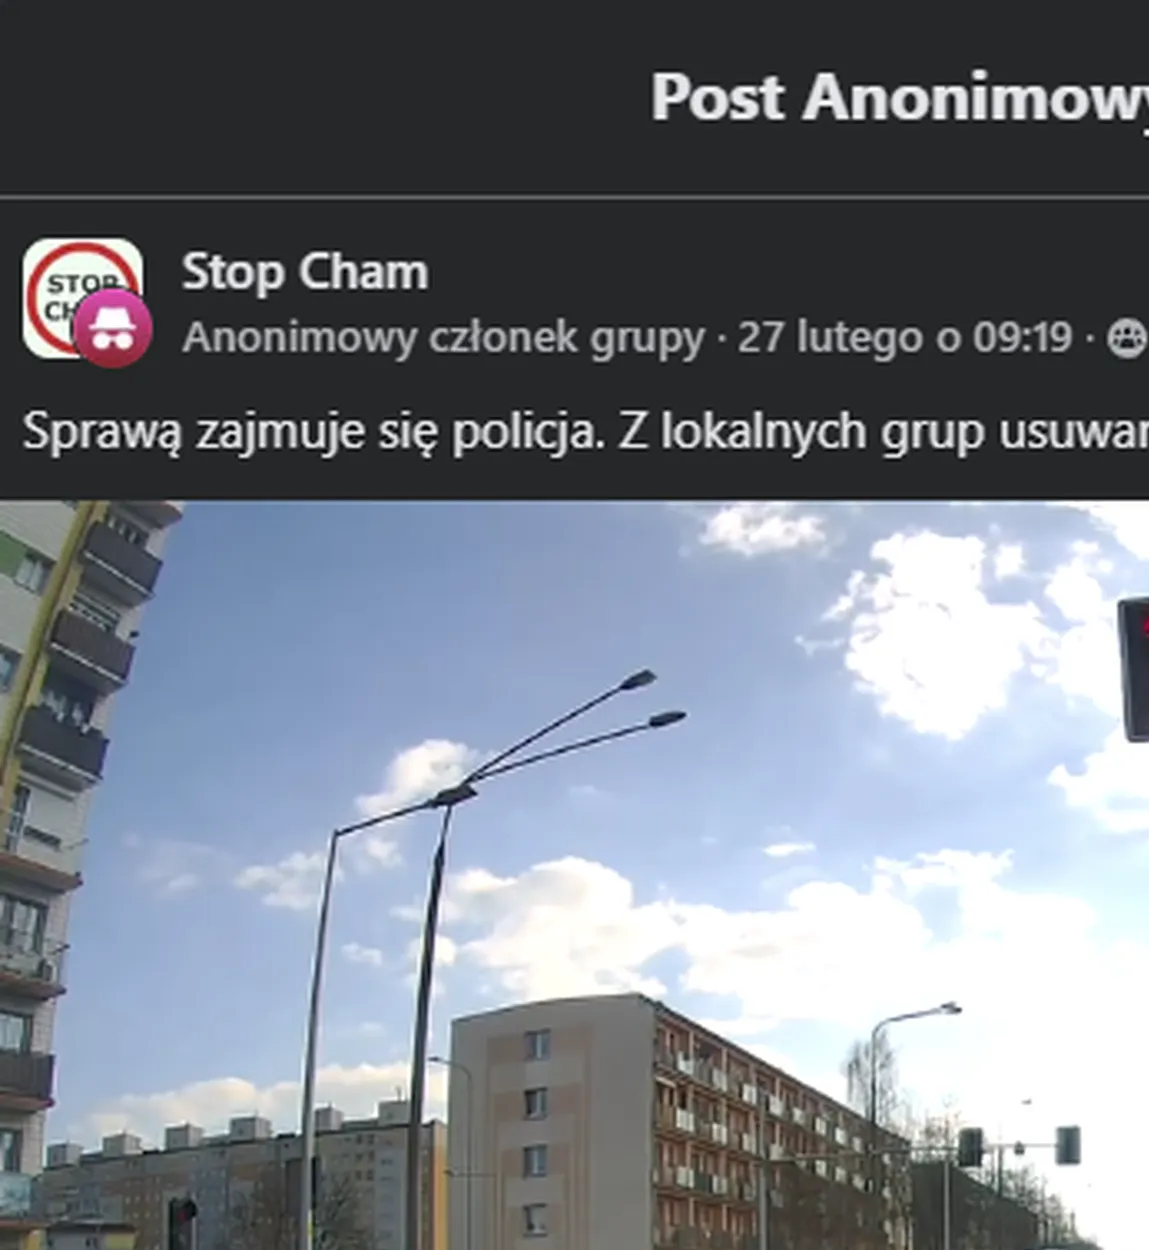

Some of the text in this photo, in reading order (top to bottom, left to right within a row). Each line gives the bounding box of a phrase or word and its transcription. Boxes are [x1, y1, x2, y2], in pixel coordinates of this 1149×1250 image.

[653, 72, 786, 120] Post
[182, 251, 428, 299] Stop Cham
[182, 318, 1072, 362] Anonimowy członek grupy 27 lutego o 09:19
[23, 410, 182, 458] Sprawą
[196, 410, 365, 458] zajmuje
[379, 410, 438, 458] się
[454, 410, 604, 458] policja.
[618, 410, 649, 449] Z
[663, 410, 866, 459] lokalnych
[882, 420, 985, 458] grup
